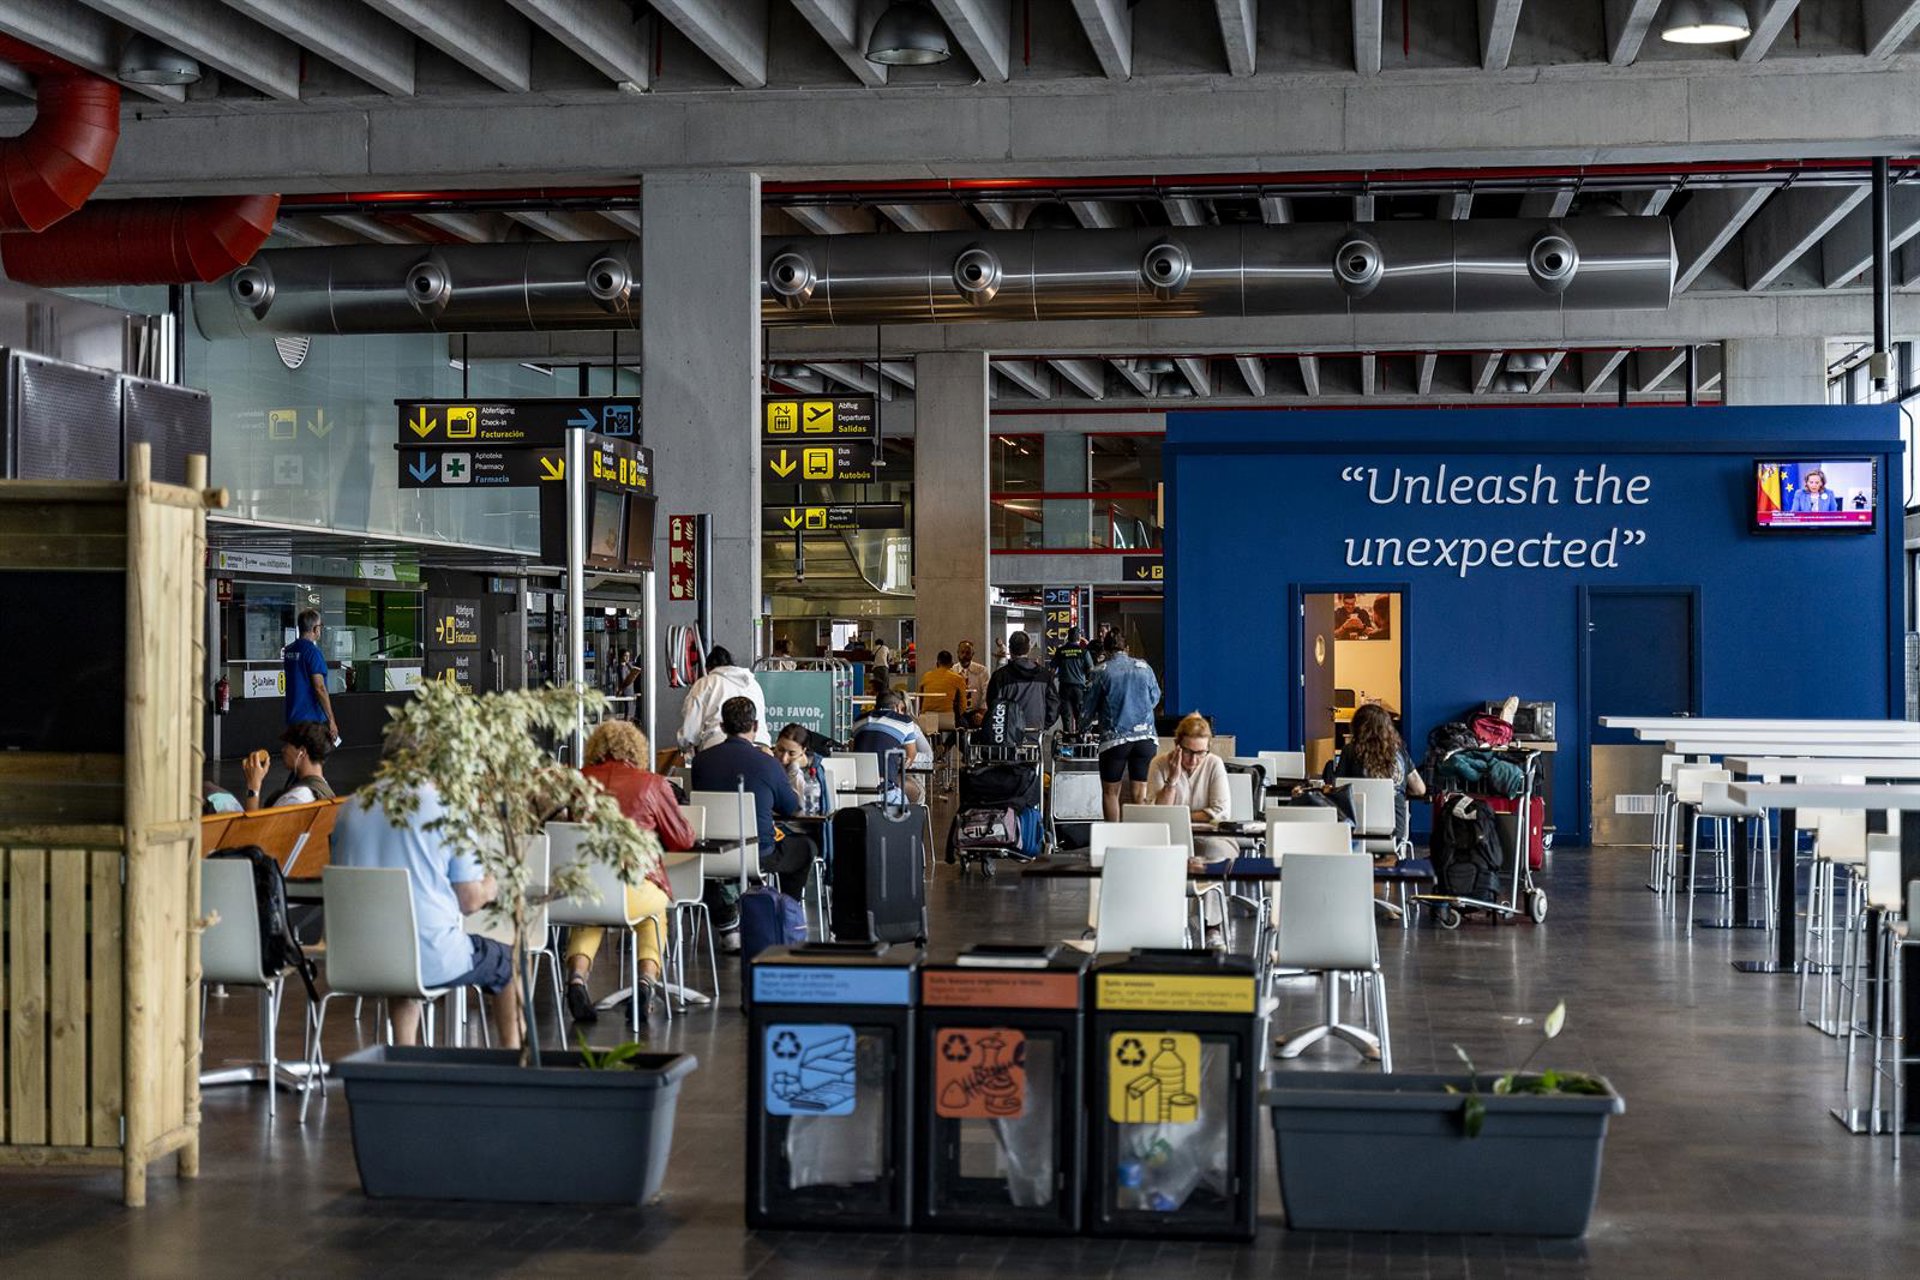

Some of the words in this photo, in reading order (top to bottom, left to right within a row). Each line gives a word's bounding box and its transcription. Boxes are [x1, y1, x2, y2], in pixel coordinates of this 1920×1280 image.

[838, 402, 858, 410] Abflug
[481, 407, 515, 415] Abfertigung
[838, 425, 867, 433] Salidas
[481, 430, 524, 438] Facturación
[475, 463, 505, 471] Pharmacy
[475, 475, 509, 483] Farmacia
[839, 471, 871, 479] Autobús
[1574, 464, 1650, 504] the
[787, 706, 825, 719] FAVOR,
[992, 703, 1006, 744] adidas
